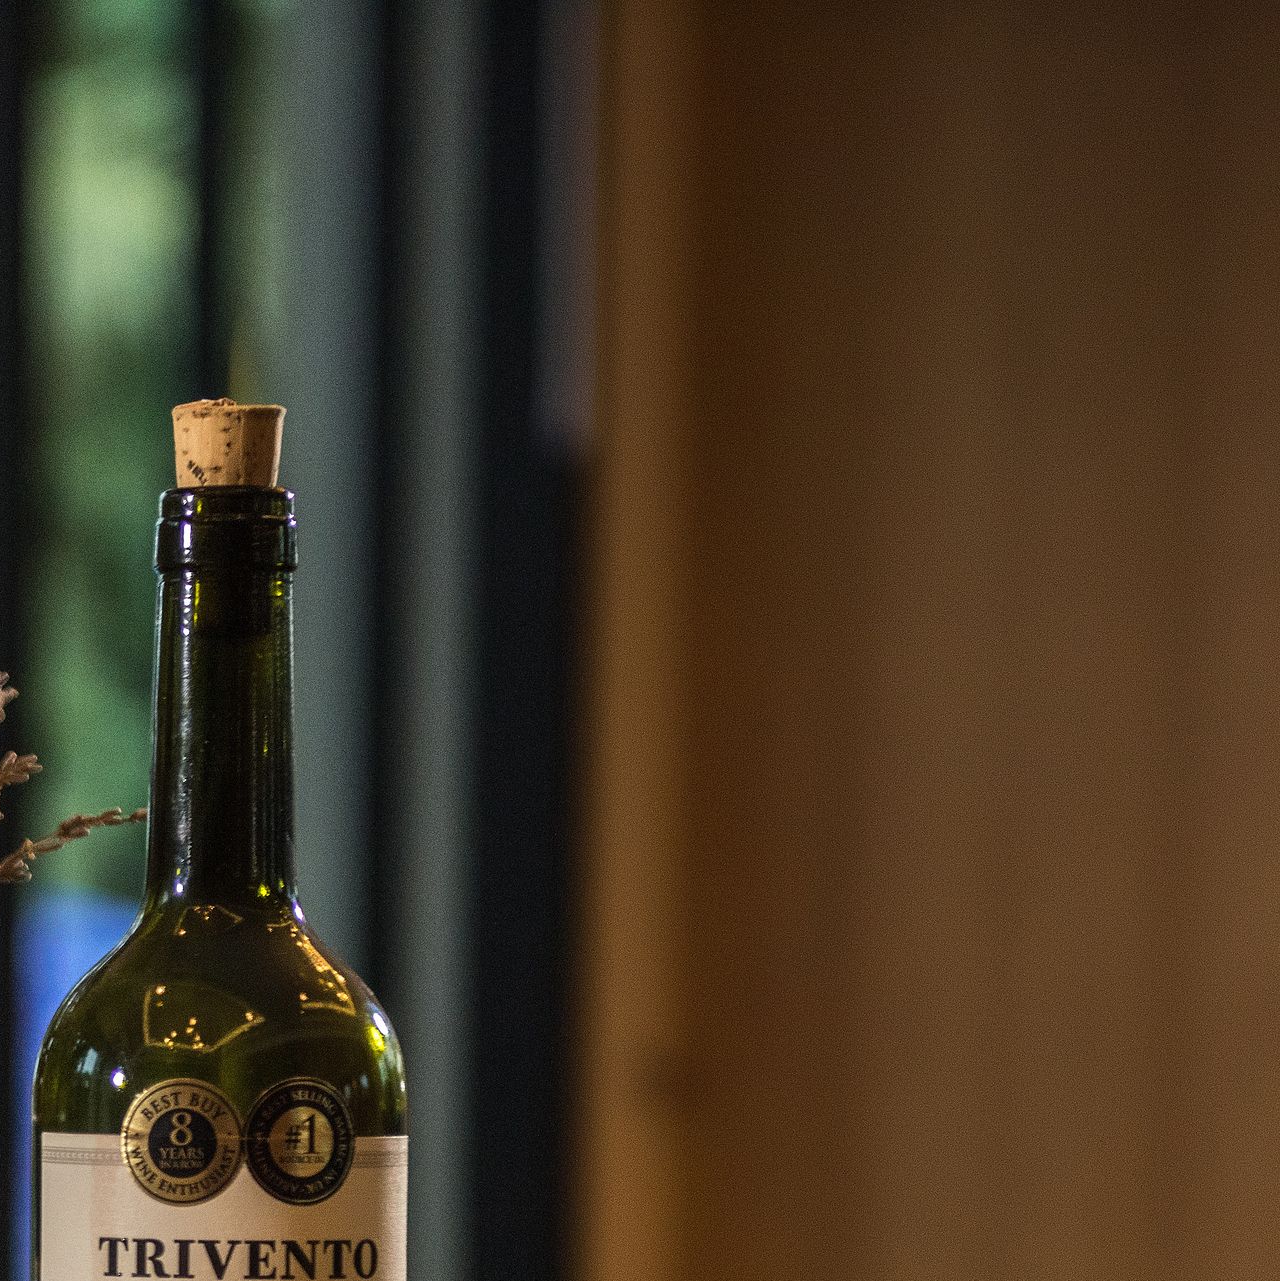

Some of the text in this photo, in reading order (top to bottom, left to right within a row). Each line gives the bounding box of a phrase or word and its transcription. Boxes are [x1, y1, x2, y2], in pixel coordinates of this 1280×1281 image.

[141, 1092, 226, 1121] BEST BUY
[170, 1111, 193, 1147] 8
[284, 1112, 320, 1155] #1
[131, 1147, 158, 1184] WINE
[158, 1147, 206, 1160] YEARS
[98, 1236, 379, 1280] TRIVENTO
